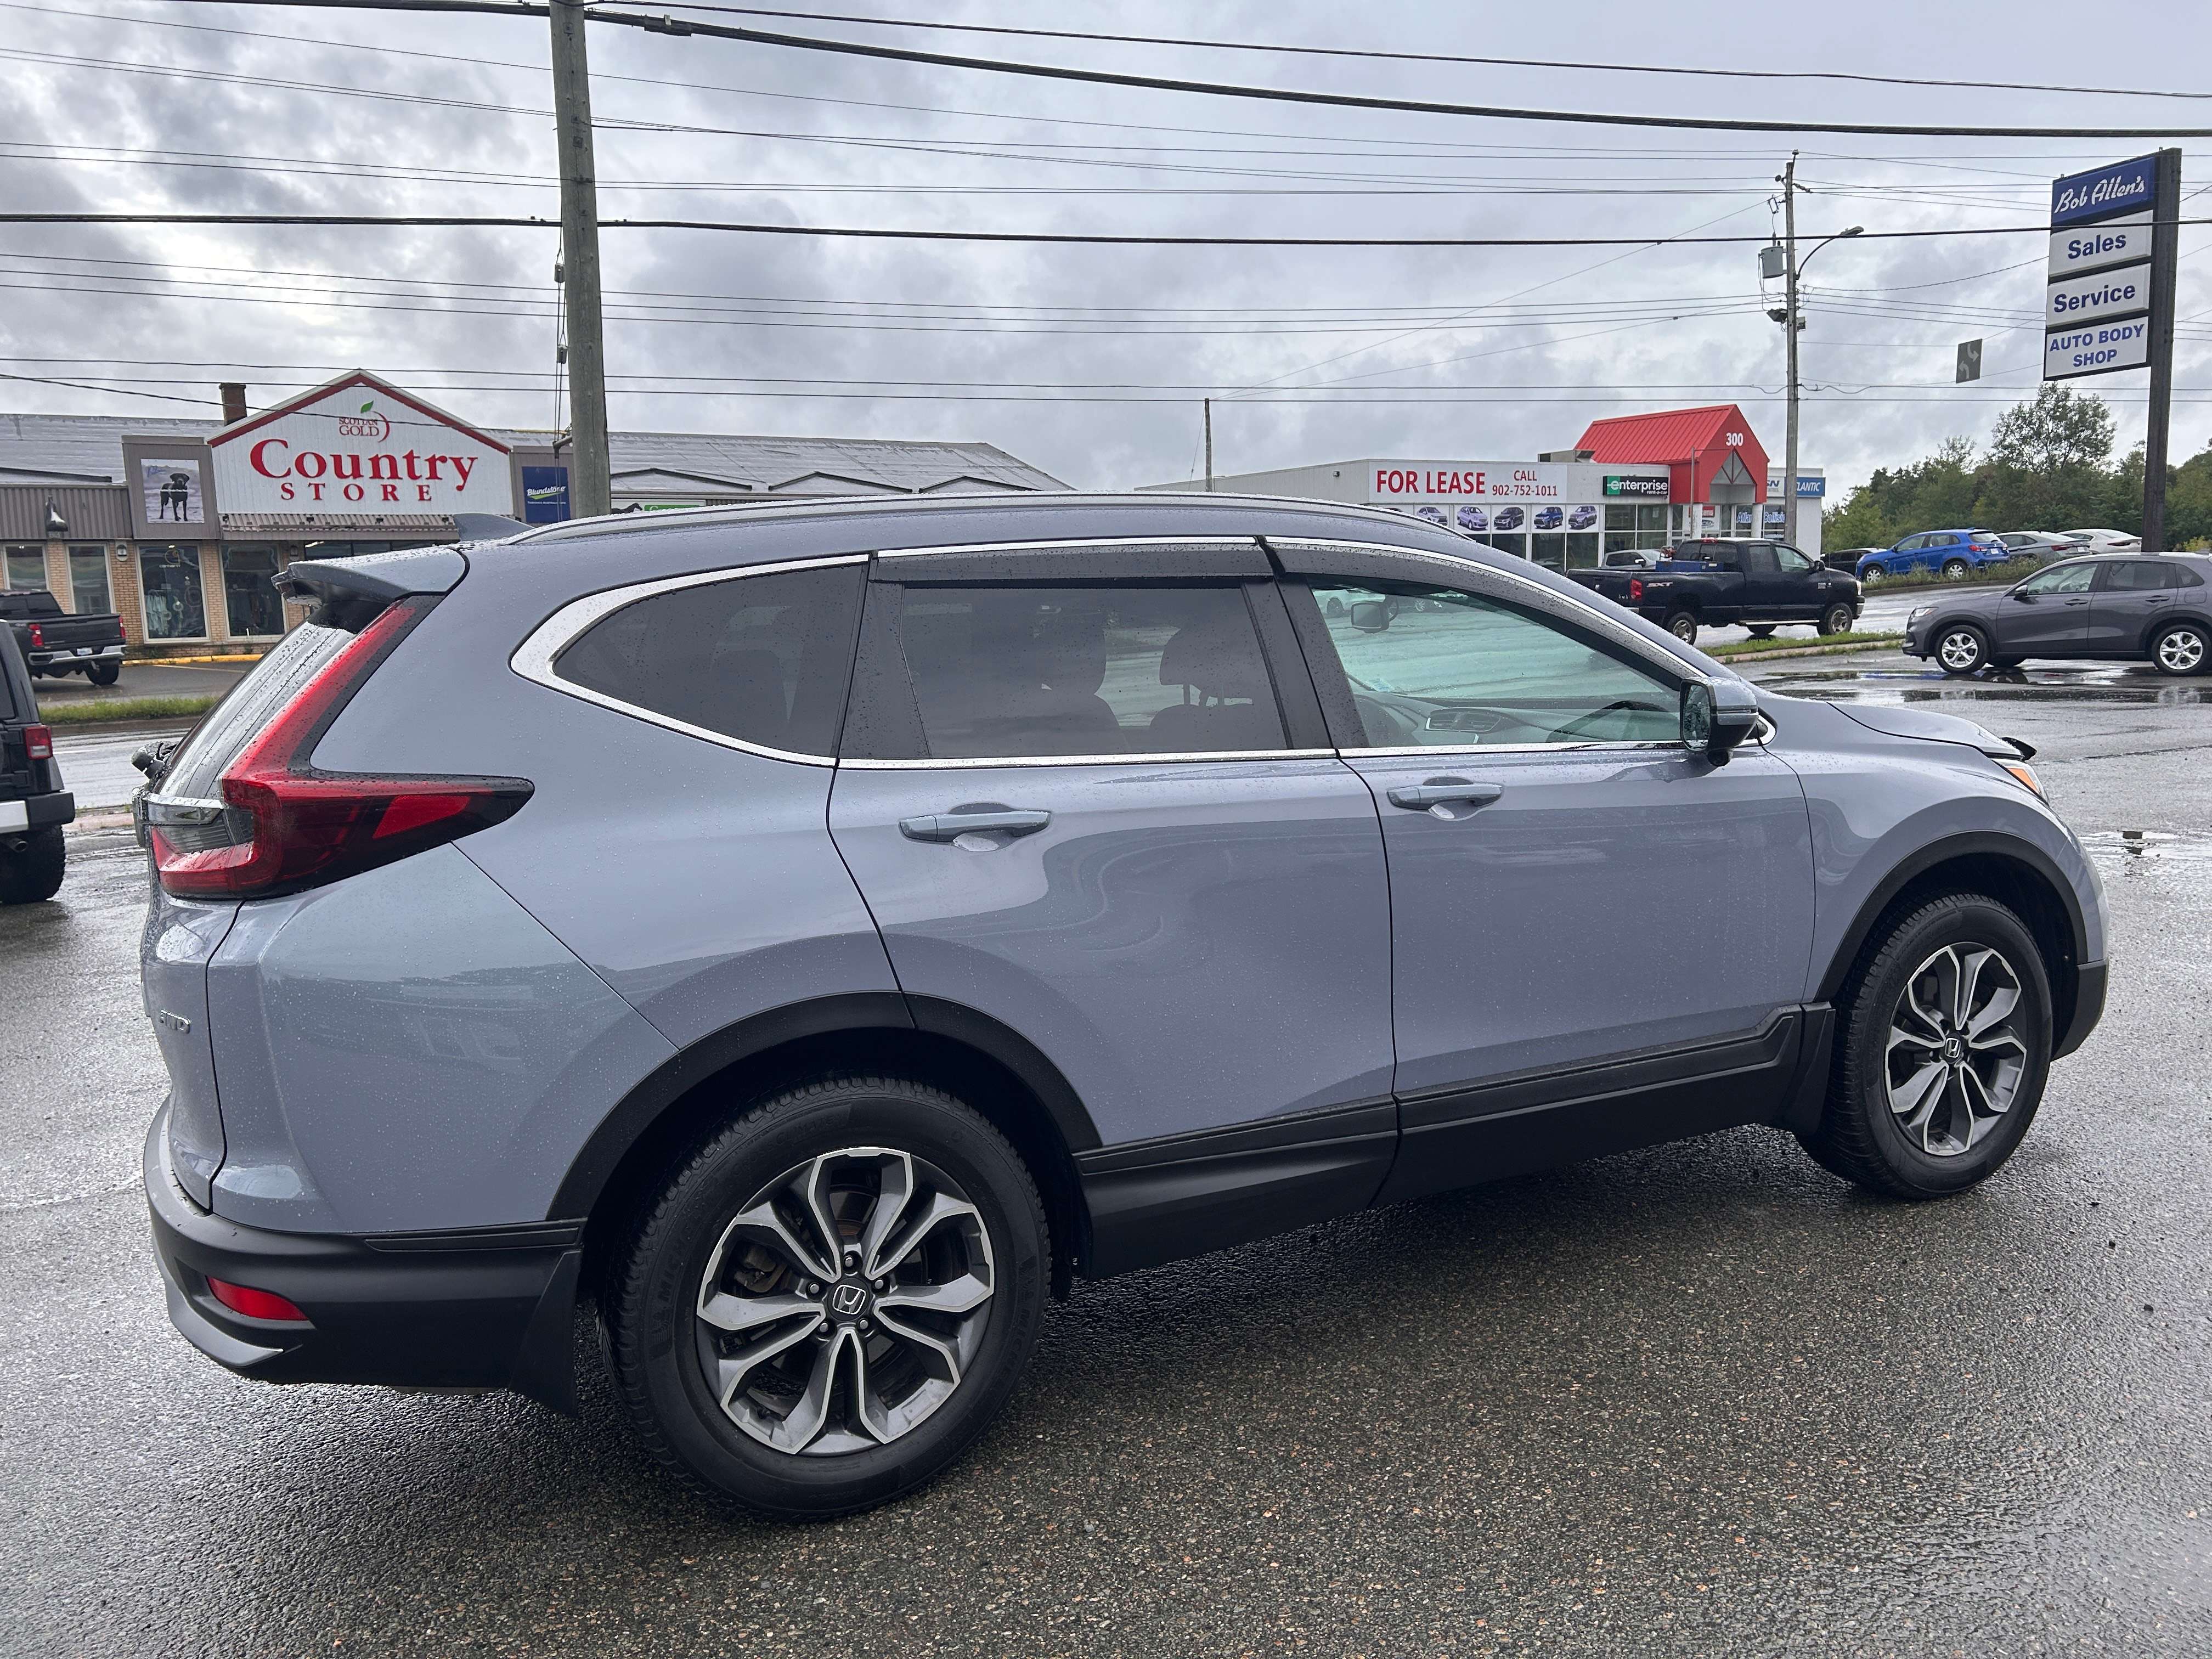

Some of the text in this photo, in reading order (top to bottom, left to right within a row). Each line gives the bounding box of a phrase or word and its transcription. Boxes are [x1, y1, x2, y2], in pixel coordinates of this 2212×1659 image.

[2054, 175, 2145, 213] Bob Allen's
[2068, 234, 2126, 259] Sales
[2054, 284, 2135, 313] Service
[2050, 324, 2145, 352] AUTO BODY
[2073, 349, 2117, 368] SHOP
[339, 425, 379, 436] GOLD
[1726, 432, 1743, 447] 300
[250, 439, 478, 491] Country
[1376, 470, 1486, 494] FOR LEASE
[1514, 470, 1537, 482] CALL
[281, 482, 432, 501] STORE
[1492, 484, 1558, 496] 902-752-1011
[1610, 479, 1668, 493] enterprise
